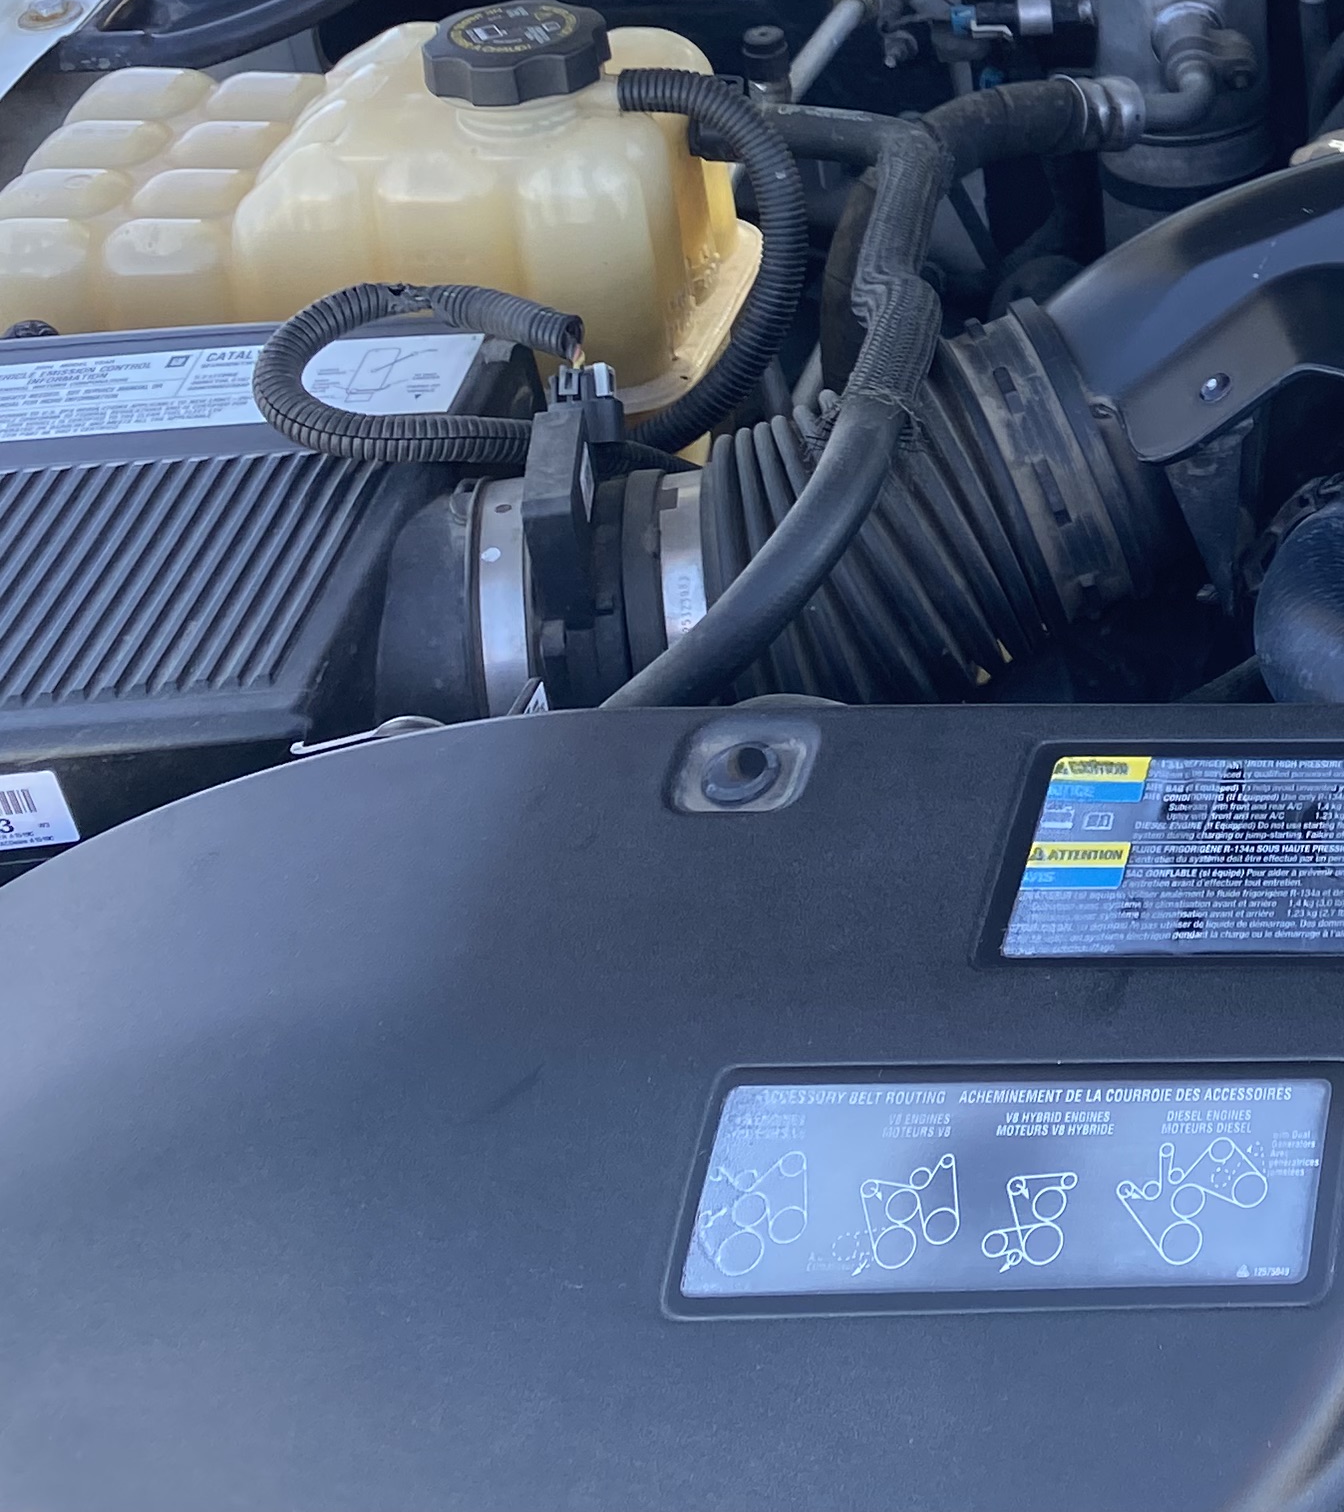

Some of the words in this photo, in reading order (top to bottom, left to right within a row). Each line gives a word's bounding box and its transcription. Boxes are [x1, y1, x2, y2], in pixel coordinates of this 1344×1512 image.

[0, 370, 35, 381] EHICLE
[38, 367, 96, 379] EMISSION
[99, 362, 151, 373] CONTROL
[27, 373, 108, 385] INFORMATION
[1303, 821, 1335, 830] starting
[1224, 845, 1255, 853] R-134a
[1282, 844, 1309, 852] HAUTE
[1048, 849, 1123, 861] ATTENTION
[1145, 869, 1198, 877] GONFLABLE
[849, 1090, 882, 1105] BELT
[885, 1090, 947, 1105] ROUTING
[959, 1089, 1063, 1104] ACHEMINEMENT
[1065, 1089, 1084, 1103] DE
[1086, 1089, 1101, 1103] LA
[1106, 1088, 1173, 1102] COURROIE
[1175, 1088, 1200, 1102] DES
[1204, 1087, 1292, 1101] ACCESSOIRES
[905, 1113, 951, 1125] ENGINES
[1005, 1111, 1018, 1124] V8
[1021, 1111, 1062, 1123] HYBRID
[1064, 1111, 1110, 1123] ENGINES
[1166, 1110, 1202, 1122] DIESEL
[1206, 1109, 1251, 1121] ENGINES
[882, 1126, 935, 1138] MOTEURS
[937, 1126, 951, 1137] V8
[996, 1125, 1048, 1136] MOTEURS
[1051, 1125, 1065, 1136] V8
[1067, 1123, 1115, 1136] HYBRIDE
[1161, 1123, 1214, 1134] MOTEURS
[1216, 1122, 1252, 1134] DIESEL
